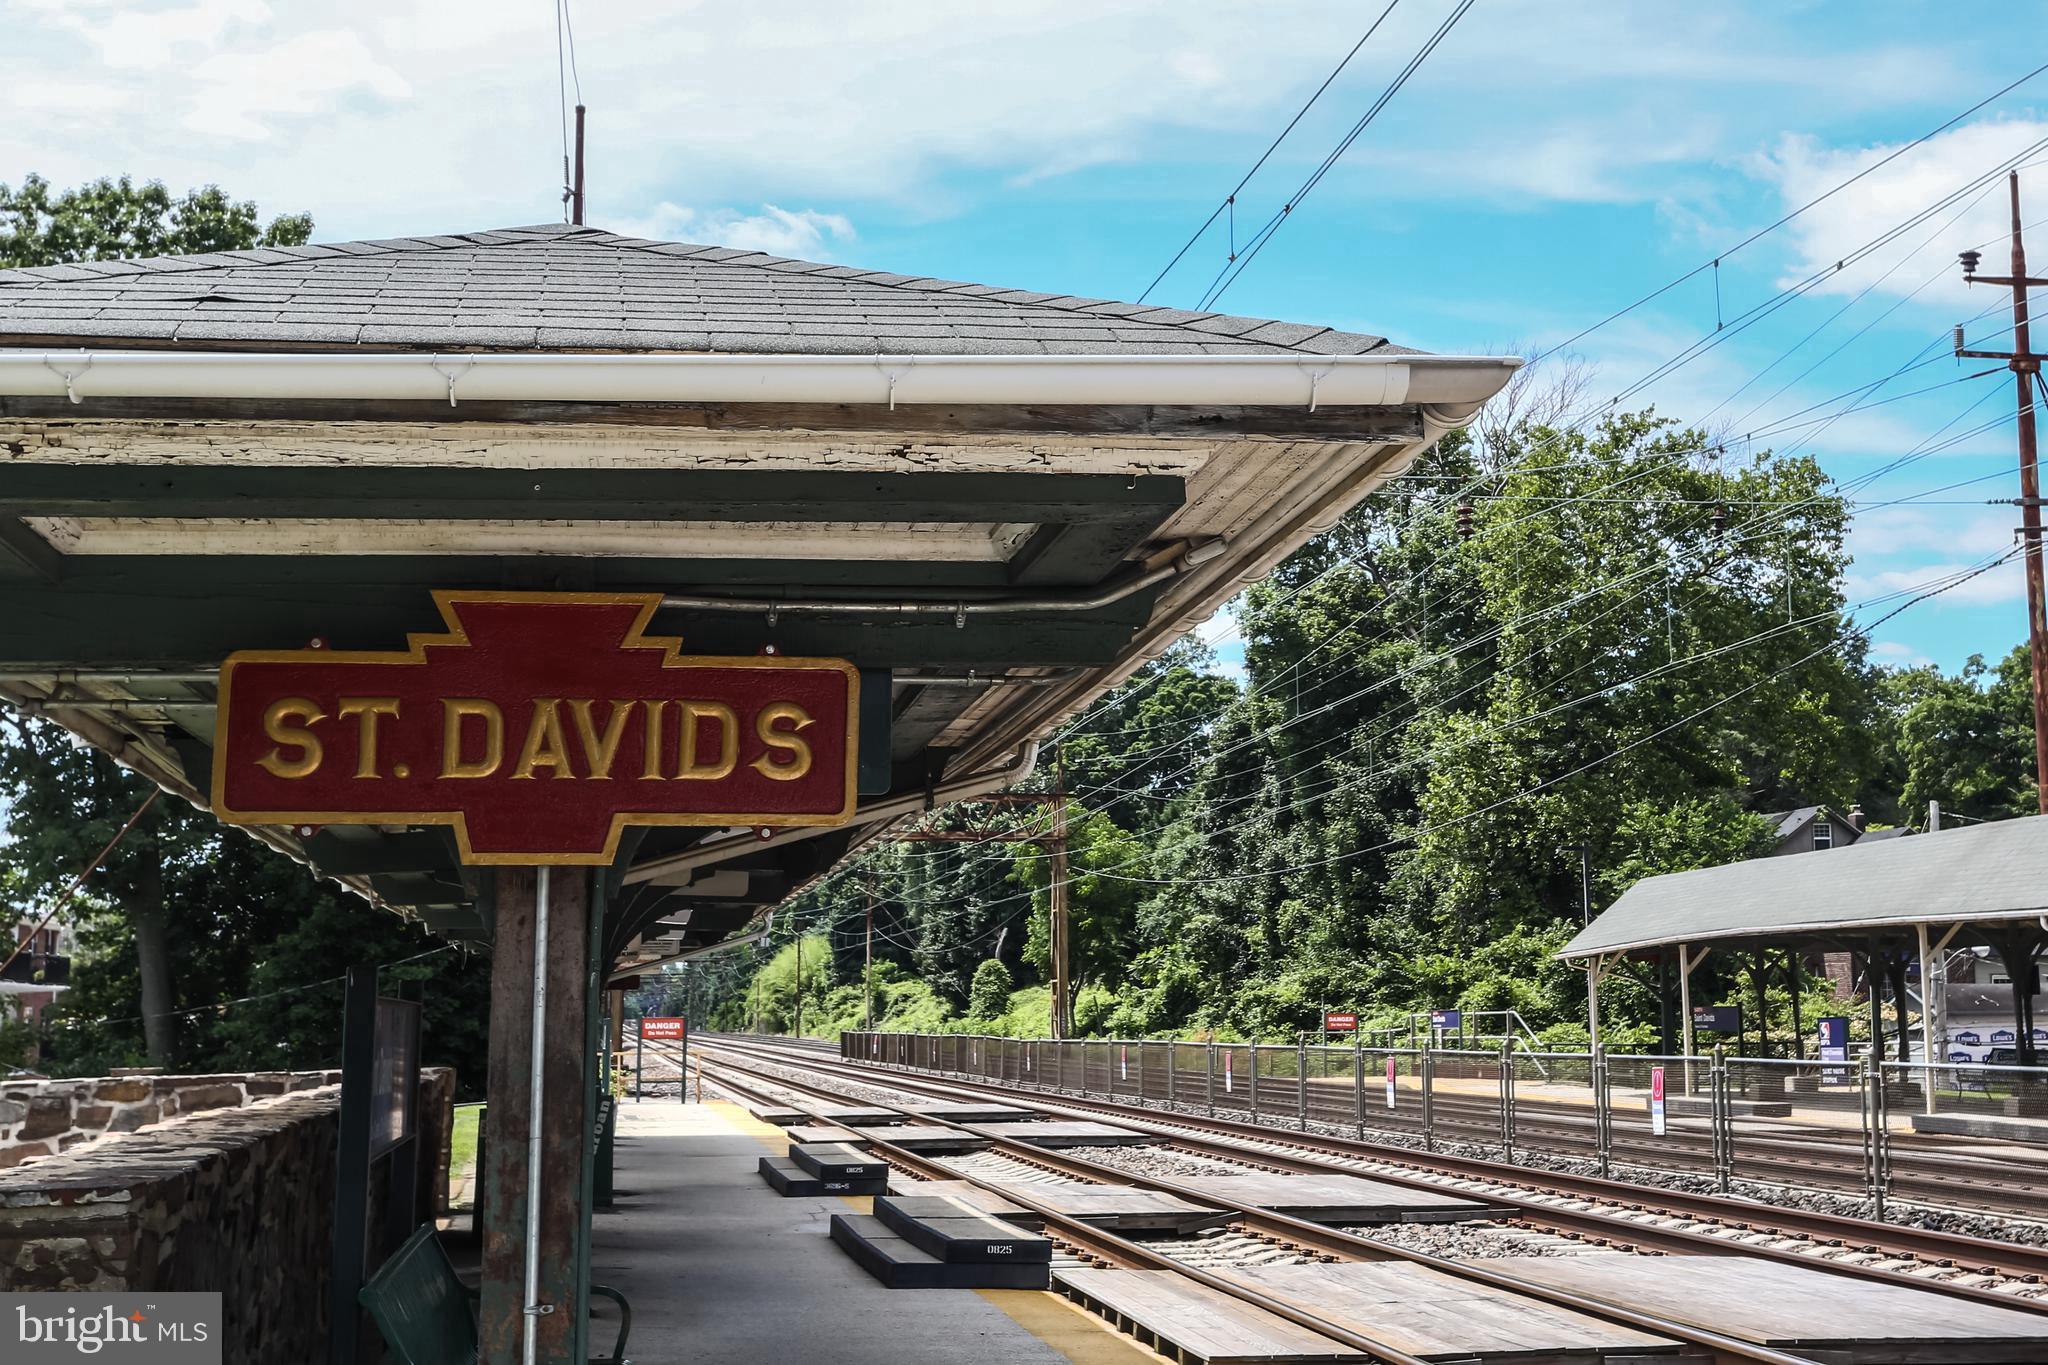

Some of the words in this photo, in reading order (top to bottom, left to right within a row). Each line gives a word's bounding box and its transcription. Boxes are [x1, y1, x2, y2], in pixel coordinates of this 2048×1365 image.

[254, 695, 411, 781] ST.
[436, 696, 817, 783] DAVIDS
[987, 1245, 1013, 1254] 0825
